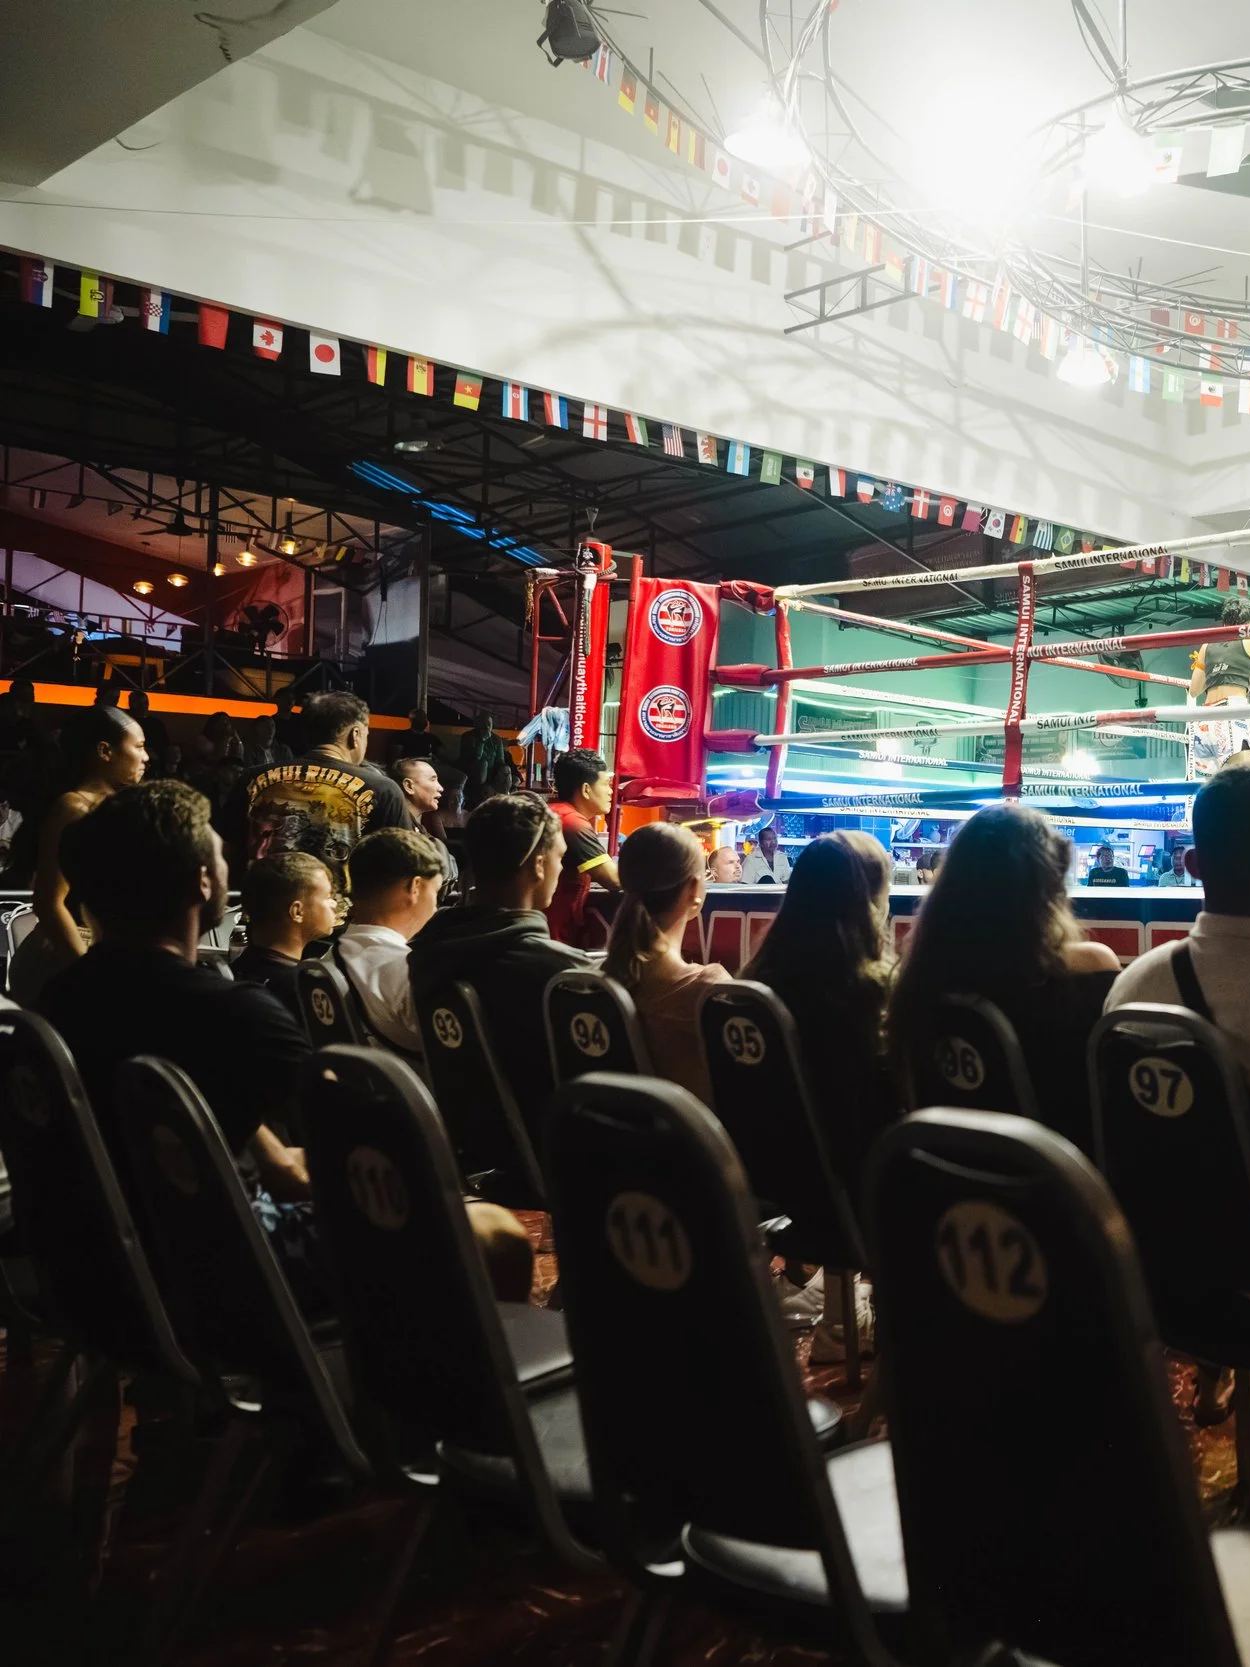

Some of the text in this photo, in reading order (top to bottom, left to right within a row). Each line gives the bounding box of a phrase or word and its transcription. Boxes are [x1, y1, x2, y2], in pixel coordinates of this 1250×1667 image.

[1054, 546, 1168, 571] SAMUI INTERNATIONAL
[1007, 575, 1031, 726] SAMUI INTERNATIONAL
[1027, 639, 1126, 658] MUI INTERNATIONAL
[823, 657, 918, 674] SAMUI INTERNATIONAL
[1037, 717, 1071, 730] SAMUI
[858, 751, 949, 767] SAMUI INTERNATIONAL
[1021, 766, 1041, 776] AMUI
[822, 793, 924, 808] SAMUI INTERNATIONAL
[1020, 784, 1144, 797] SAMUI INTERNATIONAL
[312, 990, 333, 1023] 92
[433, 1011, 461, 1046] 93
[574, 1015, 608, 1053] 94
[726, 1019, 764, 1061] 95
[1134, 1065, 1184, 1109] 97
[609, 1201, 686, 1272] 111
[937, 1211, 1047, 1301] 112
